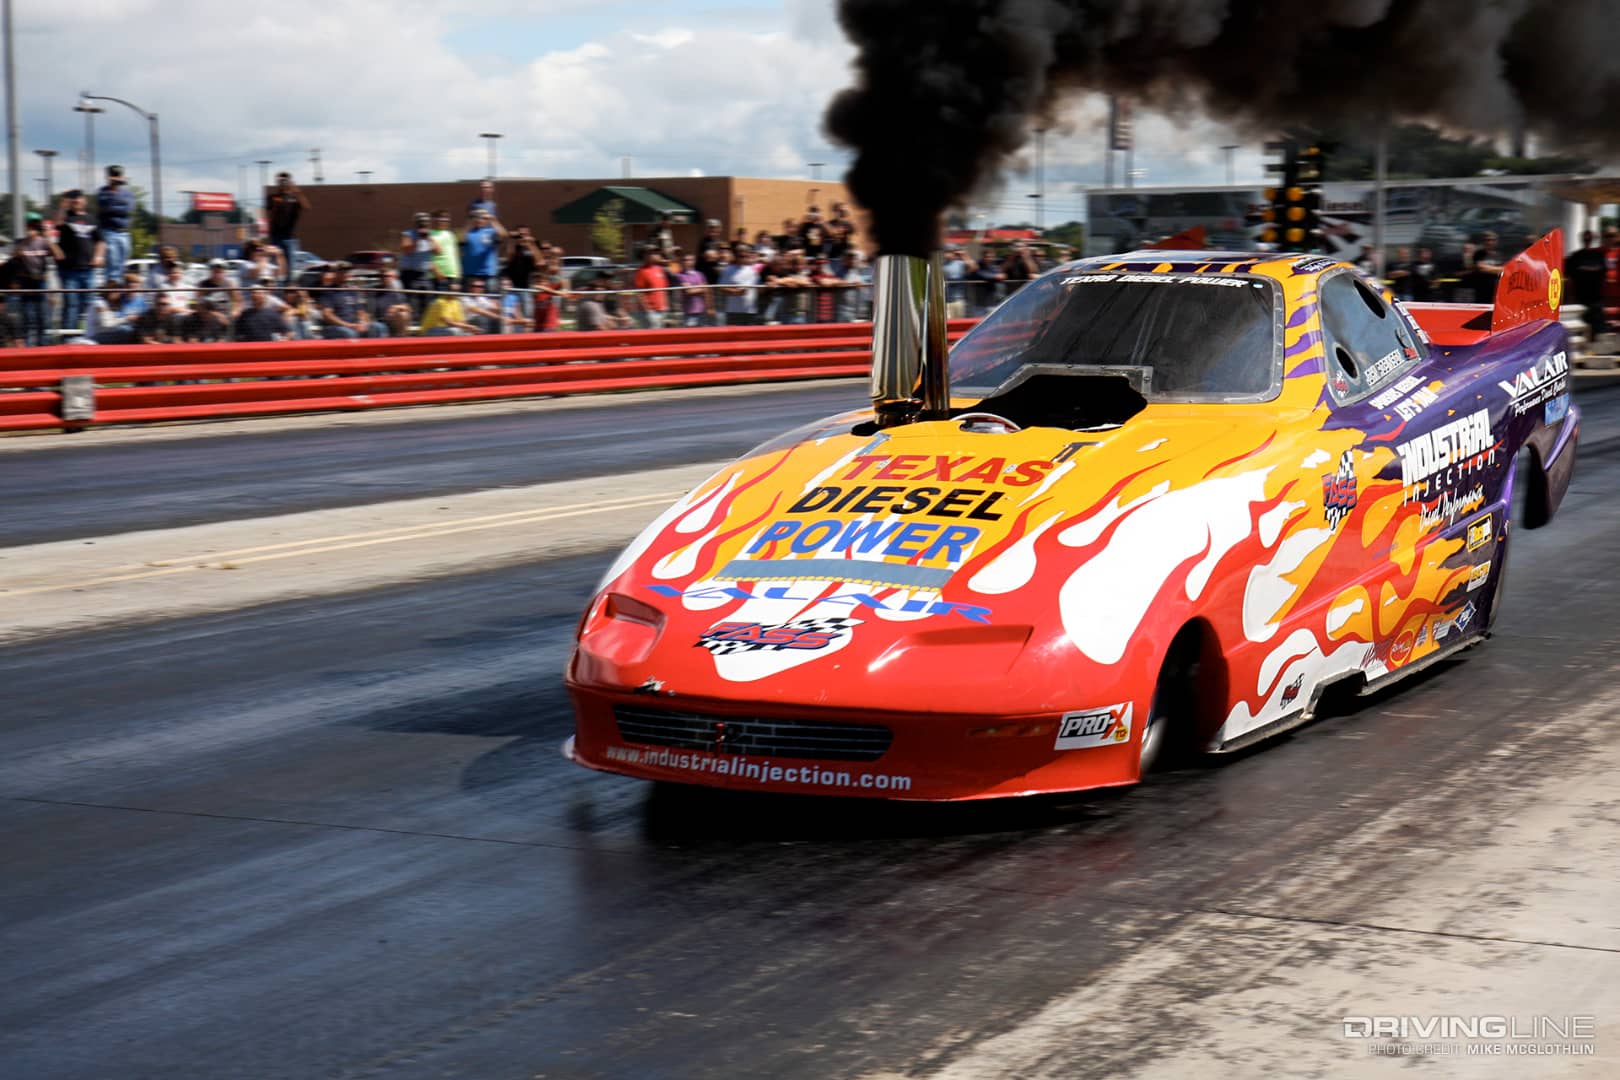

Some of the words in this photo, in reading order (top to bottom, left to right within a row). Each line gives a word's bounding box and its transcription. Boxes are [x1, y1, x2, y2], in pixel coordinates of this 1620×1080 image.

[1060, 274, 1118, 285] TEXAS
[1116, 275, 1176, 285] DIESEL
[1178, 276, 1249, 288] POWER
[1498, 351, 1568, 399] VALAIR
[840, 454, 1055, 487] TEXAS
[785, 485, 1010, 521] DIESEL
[744, 519, 981, 563] POWER
[700, 621, 843, 651] FASS
[606, 746, 912, 790] www.industrialinjection.com
